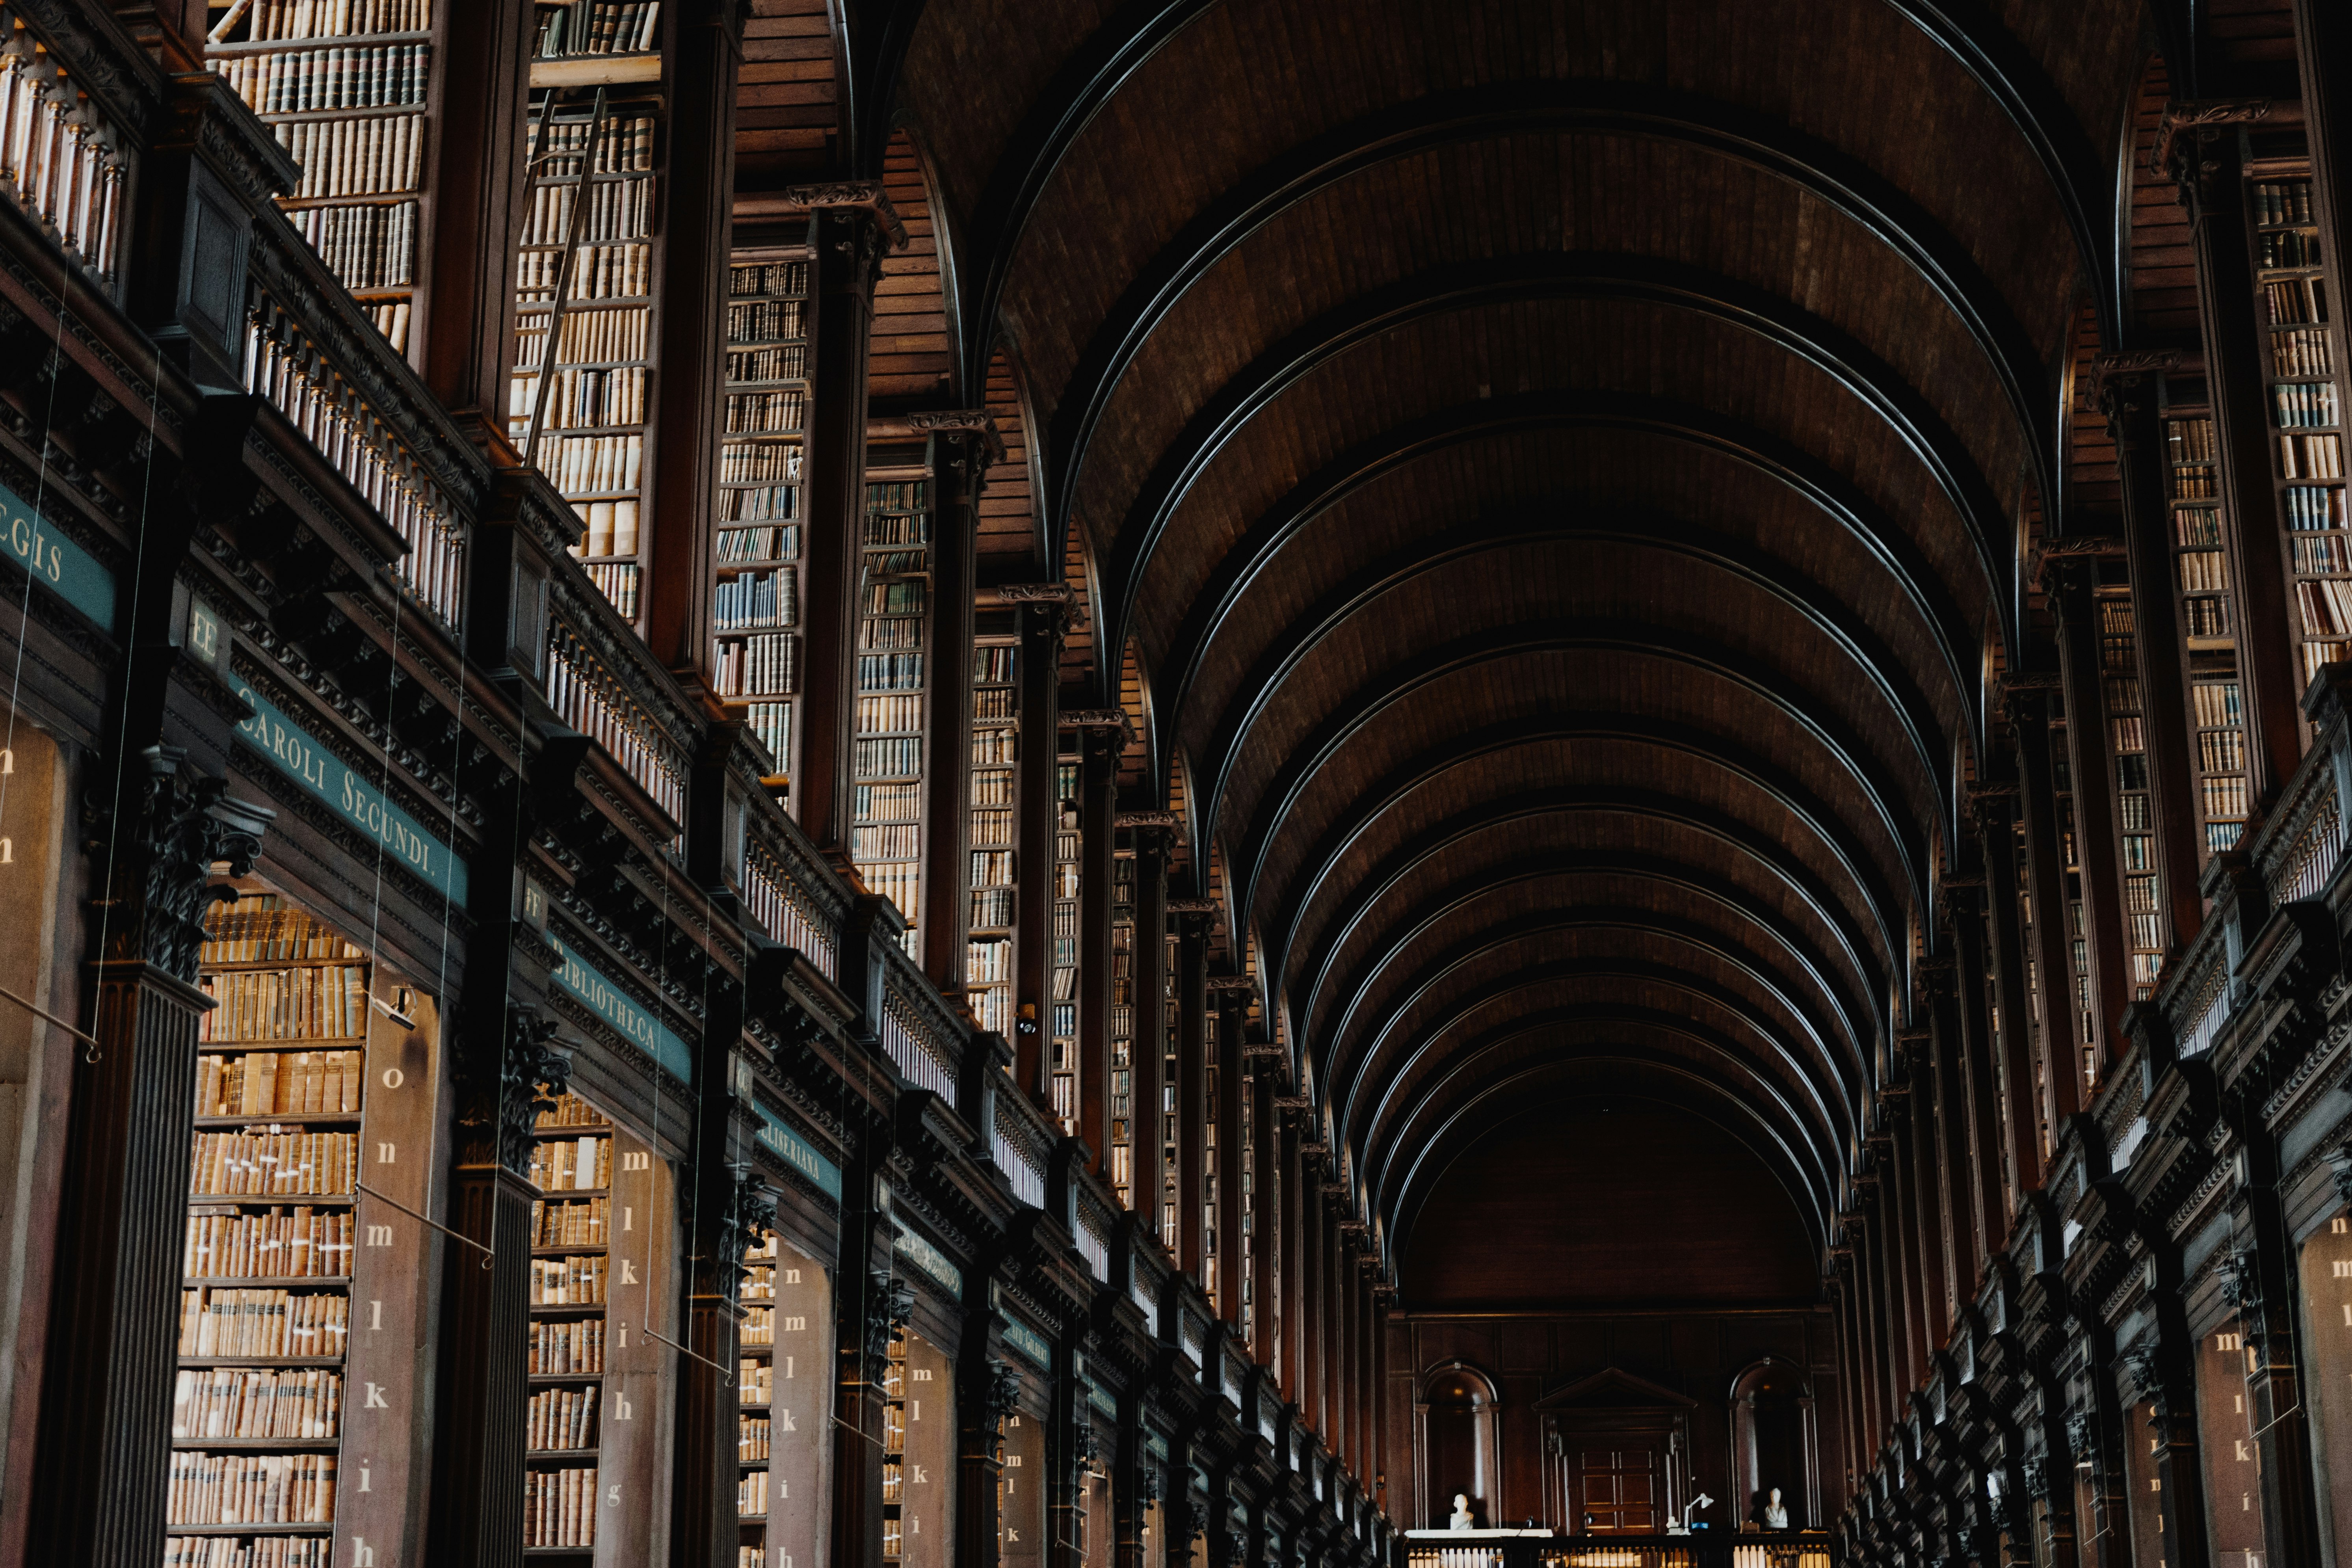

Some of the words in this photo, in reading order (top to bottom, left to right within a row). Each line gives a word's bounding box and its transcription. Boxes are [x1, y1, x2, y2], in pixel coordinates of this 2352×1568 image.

[192, 611, 217, 658] EE
[238, 687, 325, 790] CAROLI
[382, 1068, 403, 1088] o
[377, 1142, 395, 1163] n
[623, 1151, 649, 1171] m
[623, 1207, 632, 1231] l
[2331, 1218, 2348, 1234] n
[366, 1225, 392, 1246] m
[620, 1259, 639, 1285] k
[785, 1269, 801, 1284] n
[369, 1300, 382, 1330] l
[785, 1316, 806, 1332] m
[618, 1322, 627, 1348] i
[2216, 1333, 2242, 1351] m
[786, 1356, 794, 1379] l
[912, 1369, 933, 1382] m
[364, 1382, 389, 1408] k
[2235, 1394, 2243, 1414] l
[614, 1392, 632, 1420] h
[912, 1400, 920, 1421] l
[782, 1408, 796, 1432] k
[1010, 1415, 1021, 1427] n
[1006, 1455, 1022, 1467] m
[2235, 1439, 2250, 1462] k
[357, 1458, 372, 1493] i
[913, 1464, 928, 1484] k
[607, 1484, 622, 1507] g
[780, 1479, 789, 1499] i
[1008, 1478, 1014, 1494] l
[2242, 1492, 2250, 1511] i
[912, 1515, 920, 1534] i
[1008, 1527, 1020, 1542] k
[352, 1536, 374, 1568] h
[779, 1547, 793, 1568] h
